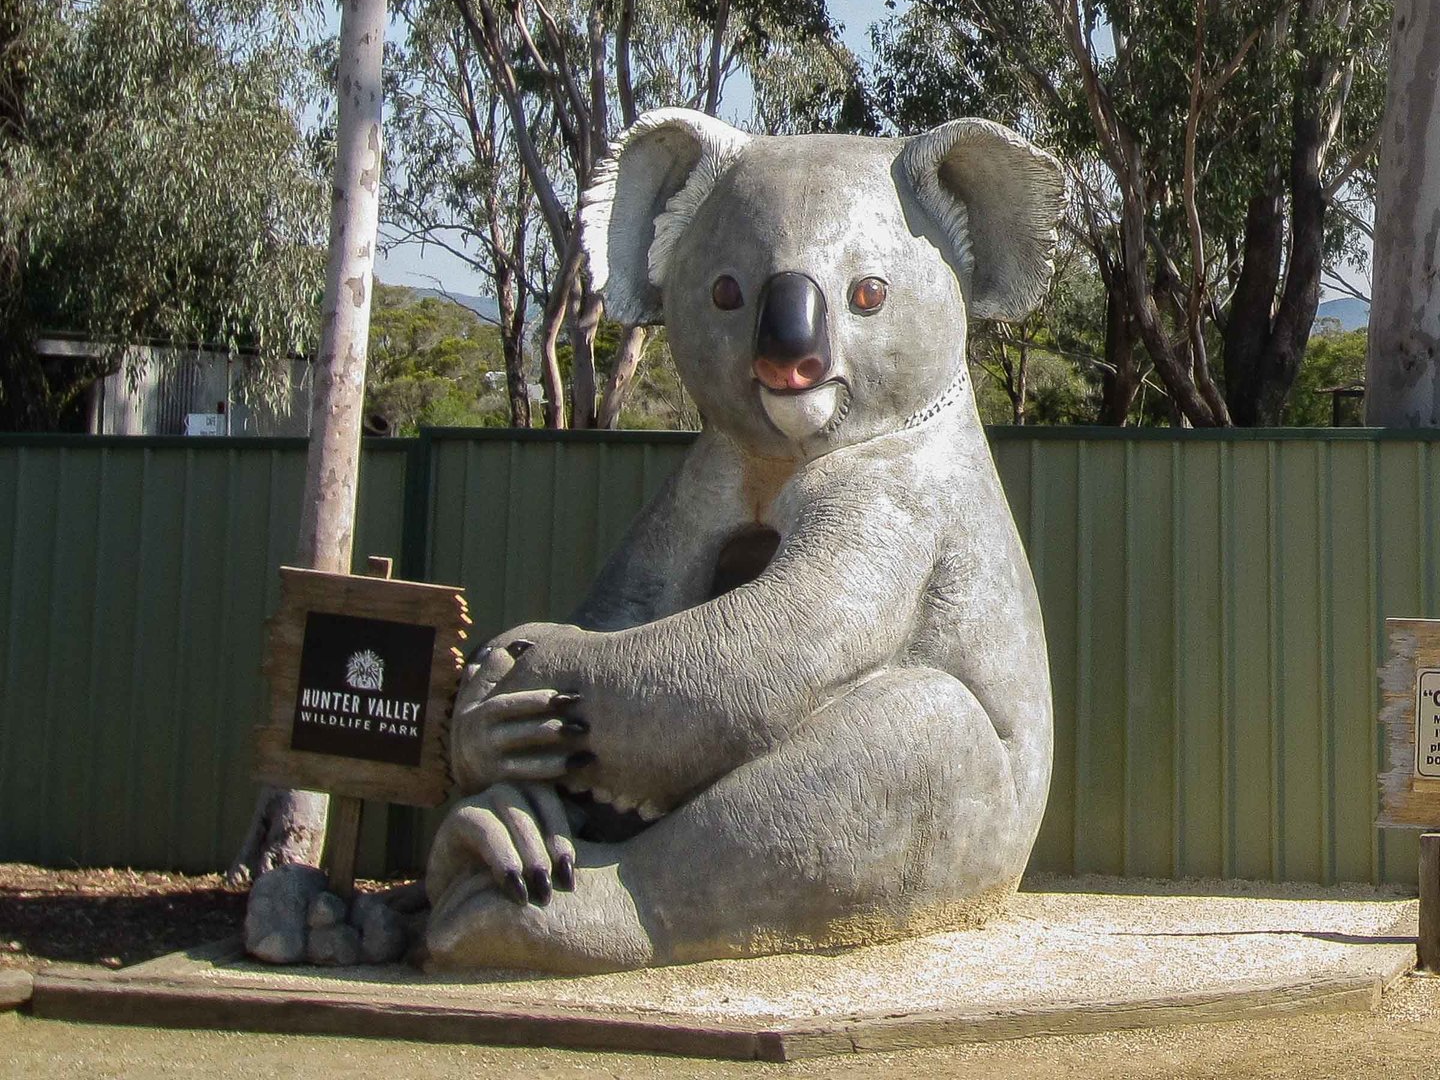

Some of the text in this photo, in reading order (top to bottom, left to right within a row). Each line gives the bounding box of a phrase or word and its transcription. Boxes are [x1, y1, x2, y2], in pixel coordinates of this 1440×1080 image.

[302, 688, 420, 722] HUNTER VALLEY
[301, 711, 418, 737] WILDLIFE PARK
